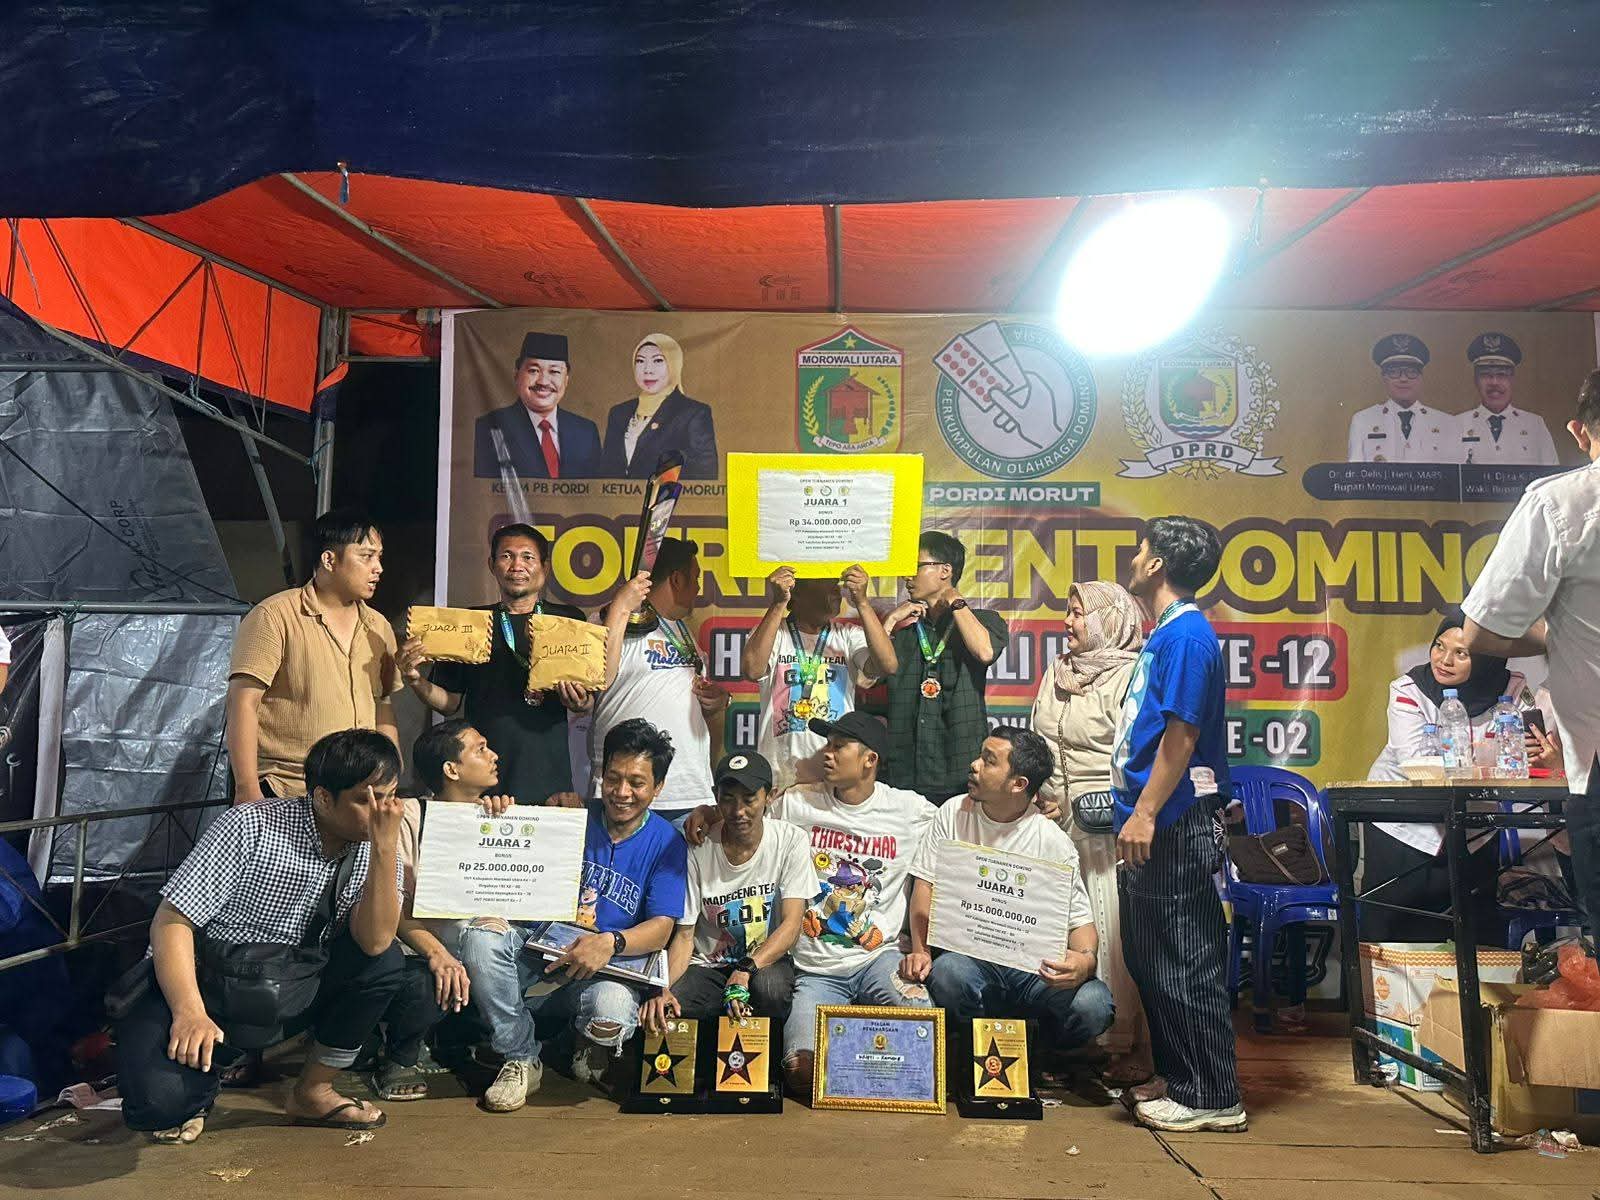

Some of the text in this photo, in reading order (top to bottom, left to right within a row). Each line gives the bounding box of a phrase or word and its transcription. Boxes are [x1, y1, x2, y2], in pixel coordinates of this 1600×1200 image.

[802, 356, 897, 364] MOROWALI UTARA
[943, 389, 1001, 473] PERKUMPULAN
[1007, 438, 1079, 474] OLAHRAGA
[1073, 376, 1090, 435] DOMINO
[1171, 444, 1234, 459] DPRD
[533, 483, 548, 495] PB
[552, 483, 589, 495] PORDI
[602, 483, 727, 497] KETUA MORUT
[930, 487, 1095, 502] PORDI MORUT
[789, 518, 862, 527] Rp 34.000.000,00
[1197, 529, 1501, 606] OMIN
[423, 624, 473, 633] JUARA III
[541, 644, 591, 658] JUARA II
[1220, 639, 1330, 684] E -12
[1252, 721, 1307, 755] -02
[479, 838, 531, 848] JUARA 2
[459, 862, 545, 873] Rp 25.000.000,00
[977, 880, 1025, 897] JUARA 3
[960, 900, 1037, 926] Rp 15.000.000,00
